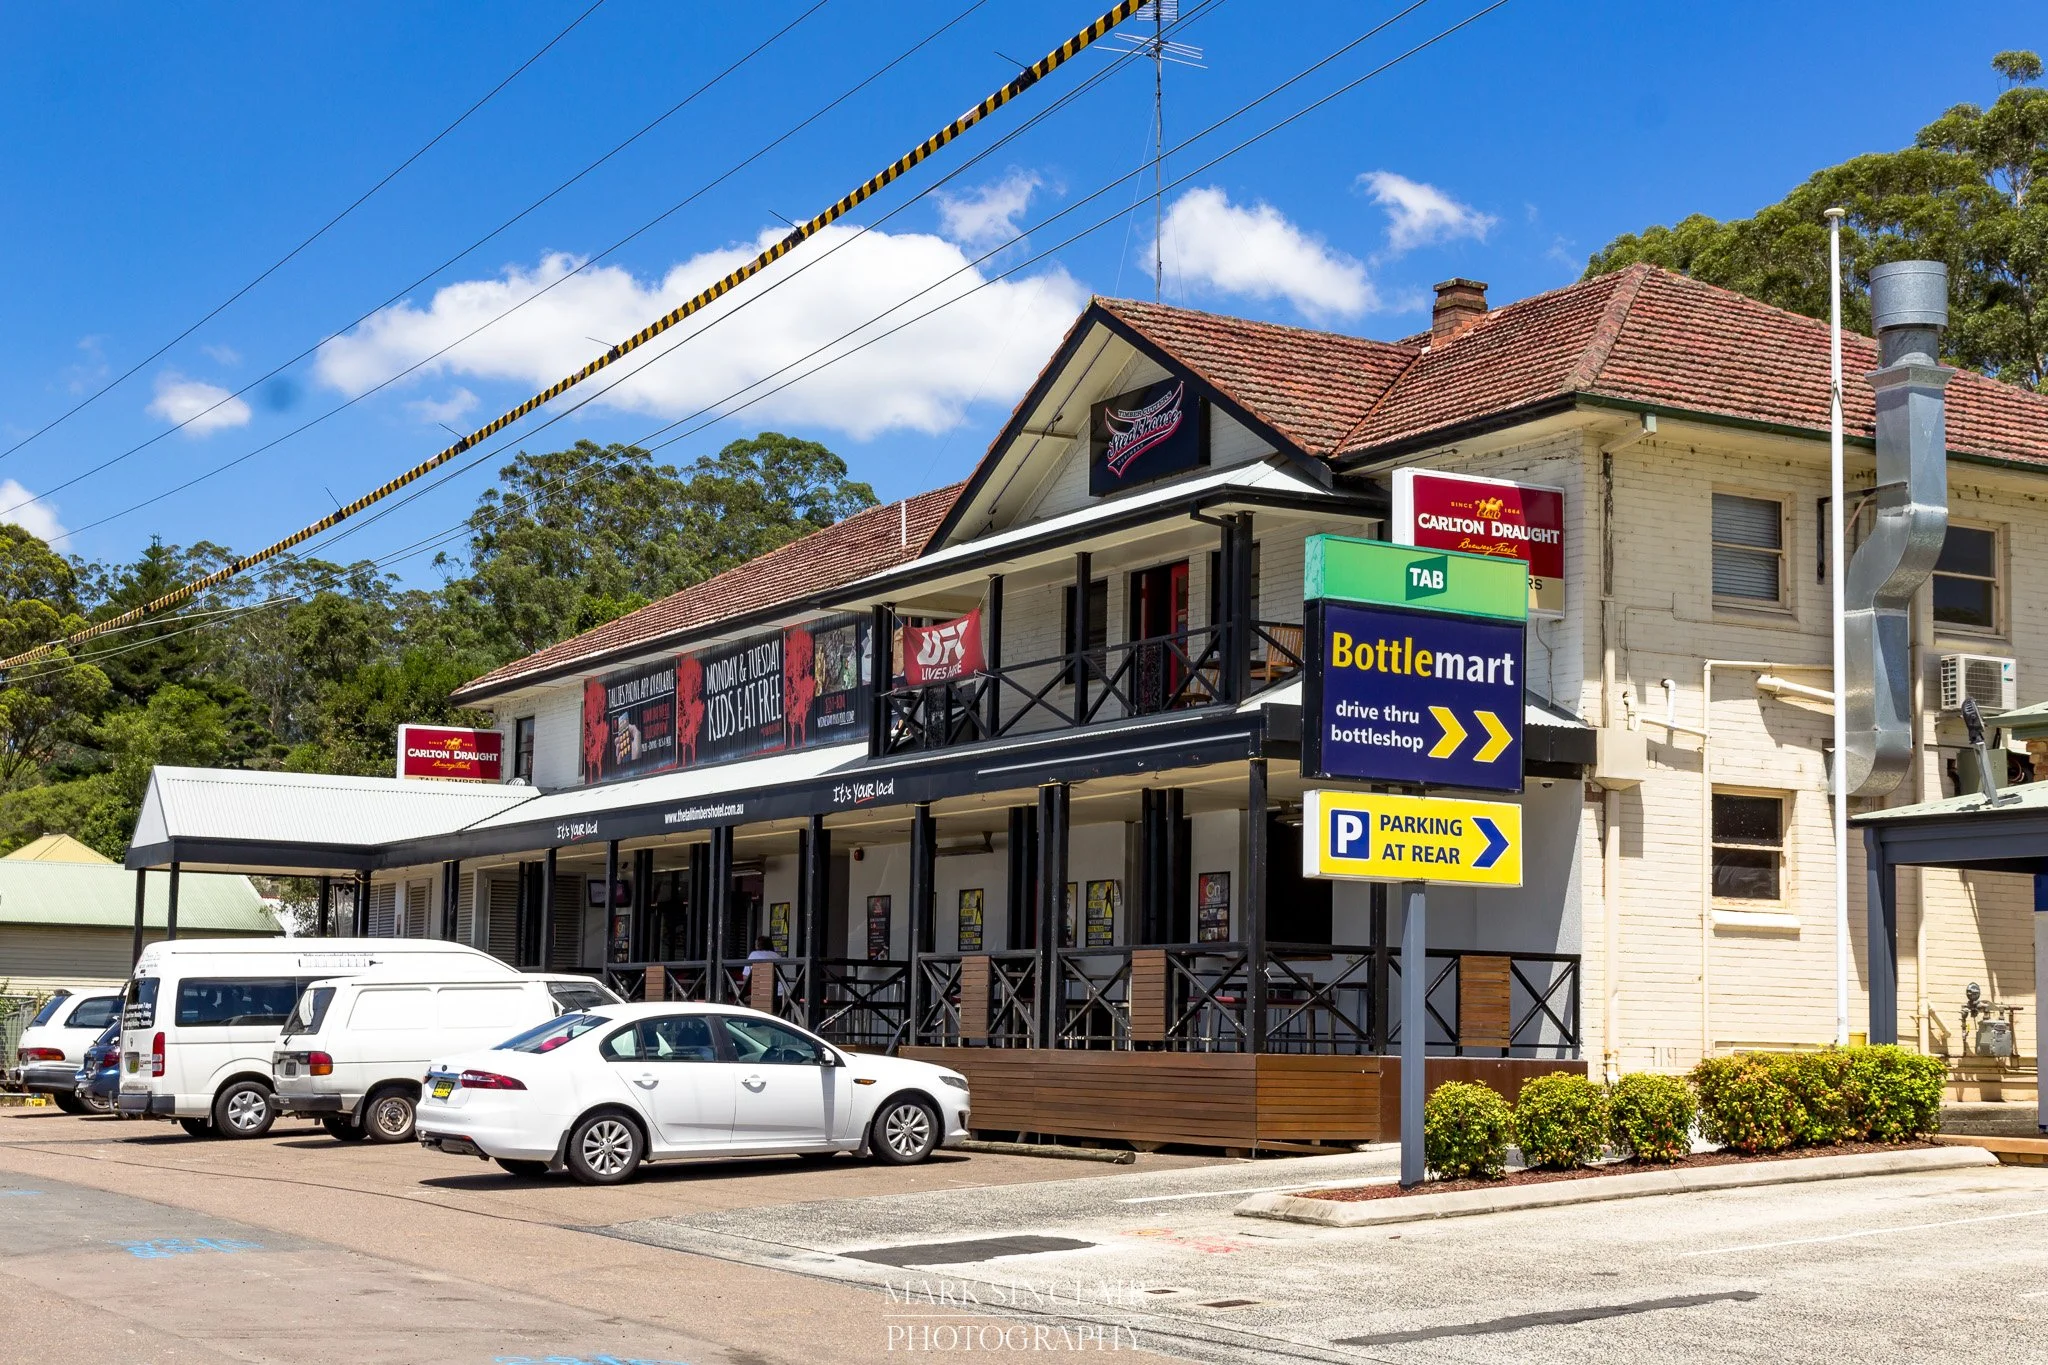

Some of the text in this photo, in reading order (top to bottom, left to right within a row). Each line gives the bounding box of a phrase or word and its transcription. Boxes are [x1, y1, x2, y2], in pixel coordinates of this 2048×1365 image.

[1107, 409, 1182, 459] Steakhouse
[1451, 501, 1473, 509] SINCE
[1417, 513, 1560, 544] CARLTON DRAUGHT
[1457, 537, 1519, 556] Brewery Fresh
[1409, 567, 1444, 589] TAB
[917, 620, 969, 665] UFC
[706, 639, 780, 695] MONDAY & TUESDAY
[1332, 631, 1515, 685] Bottlemart
[921, 666, 947, 681] LIVES
[707, 690, 736, 742] KIDS
[737, 682, 756, 732] EAT
[758, 674, 782, 725] FREE
[1335, 700, 1420, 724] drive thru
[1331, 724, 1424, 753] bottleshop
[407, 748, 499, 762] CARLTON DRAUGHT
[833, 783, 852, 804] It's
[876, 777, 894, 797] local
[556, 822, 570, 840] It's
[585, 820, 598, 835] local
[1379, 814, 1463, 837] PARKING
[1381, 842, 1460, 865] AT REAR
